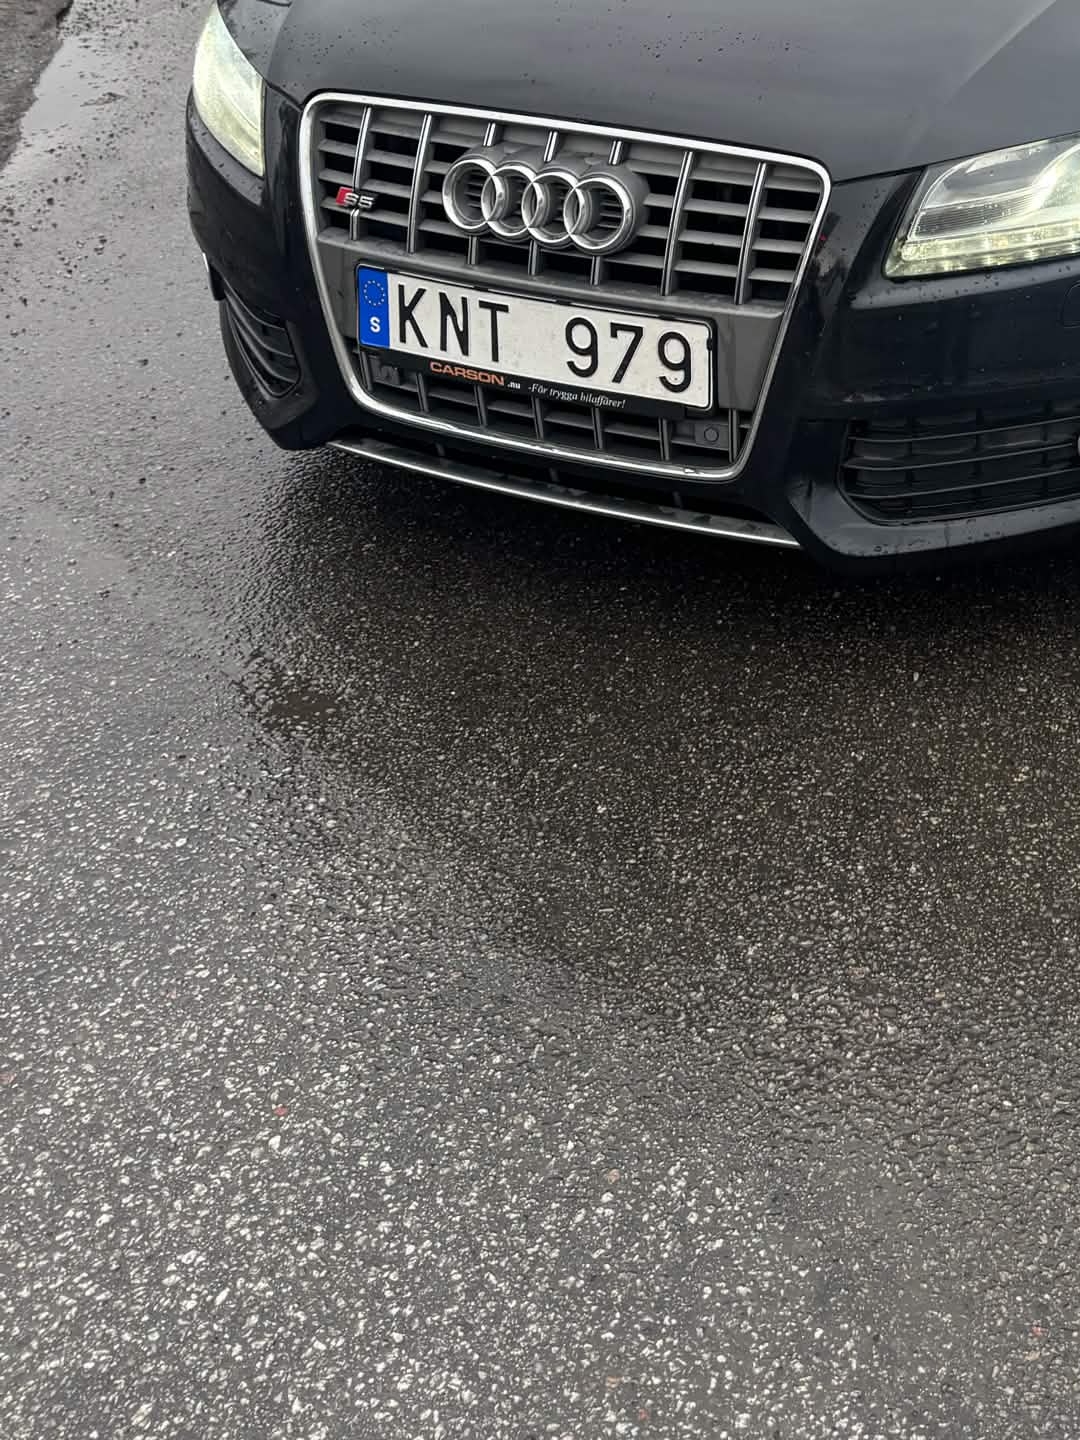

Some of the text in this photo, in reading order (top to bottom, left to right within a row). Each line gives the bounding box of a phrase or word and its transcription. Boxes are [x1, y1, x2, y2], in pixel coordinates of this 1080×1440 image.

[343, 191, 374, 209] S5
[369, 316, 381, 333] S
[397, 283, 692, 393] KNT 979
[430, 361, 505, 386] CARSON
[549, 388, 578, 402] trygga
